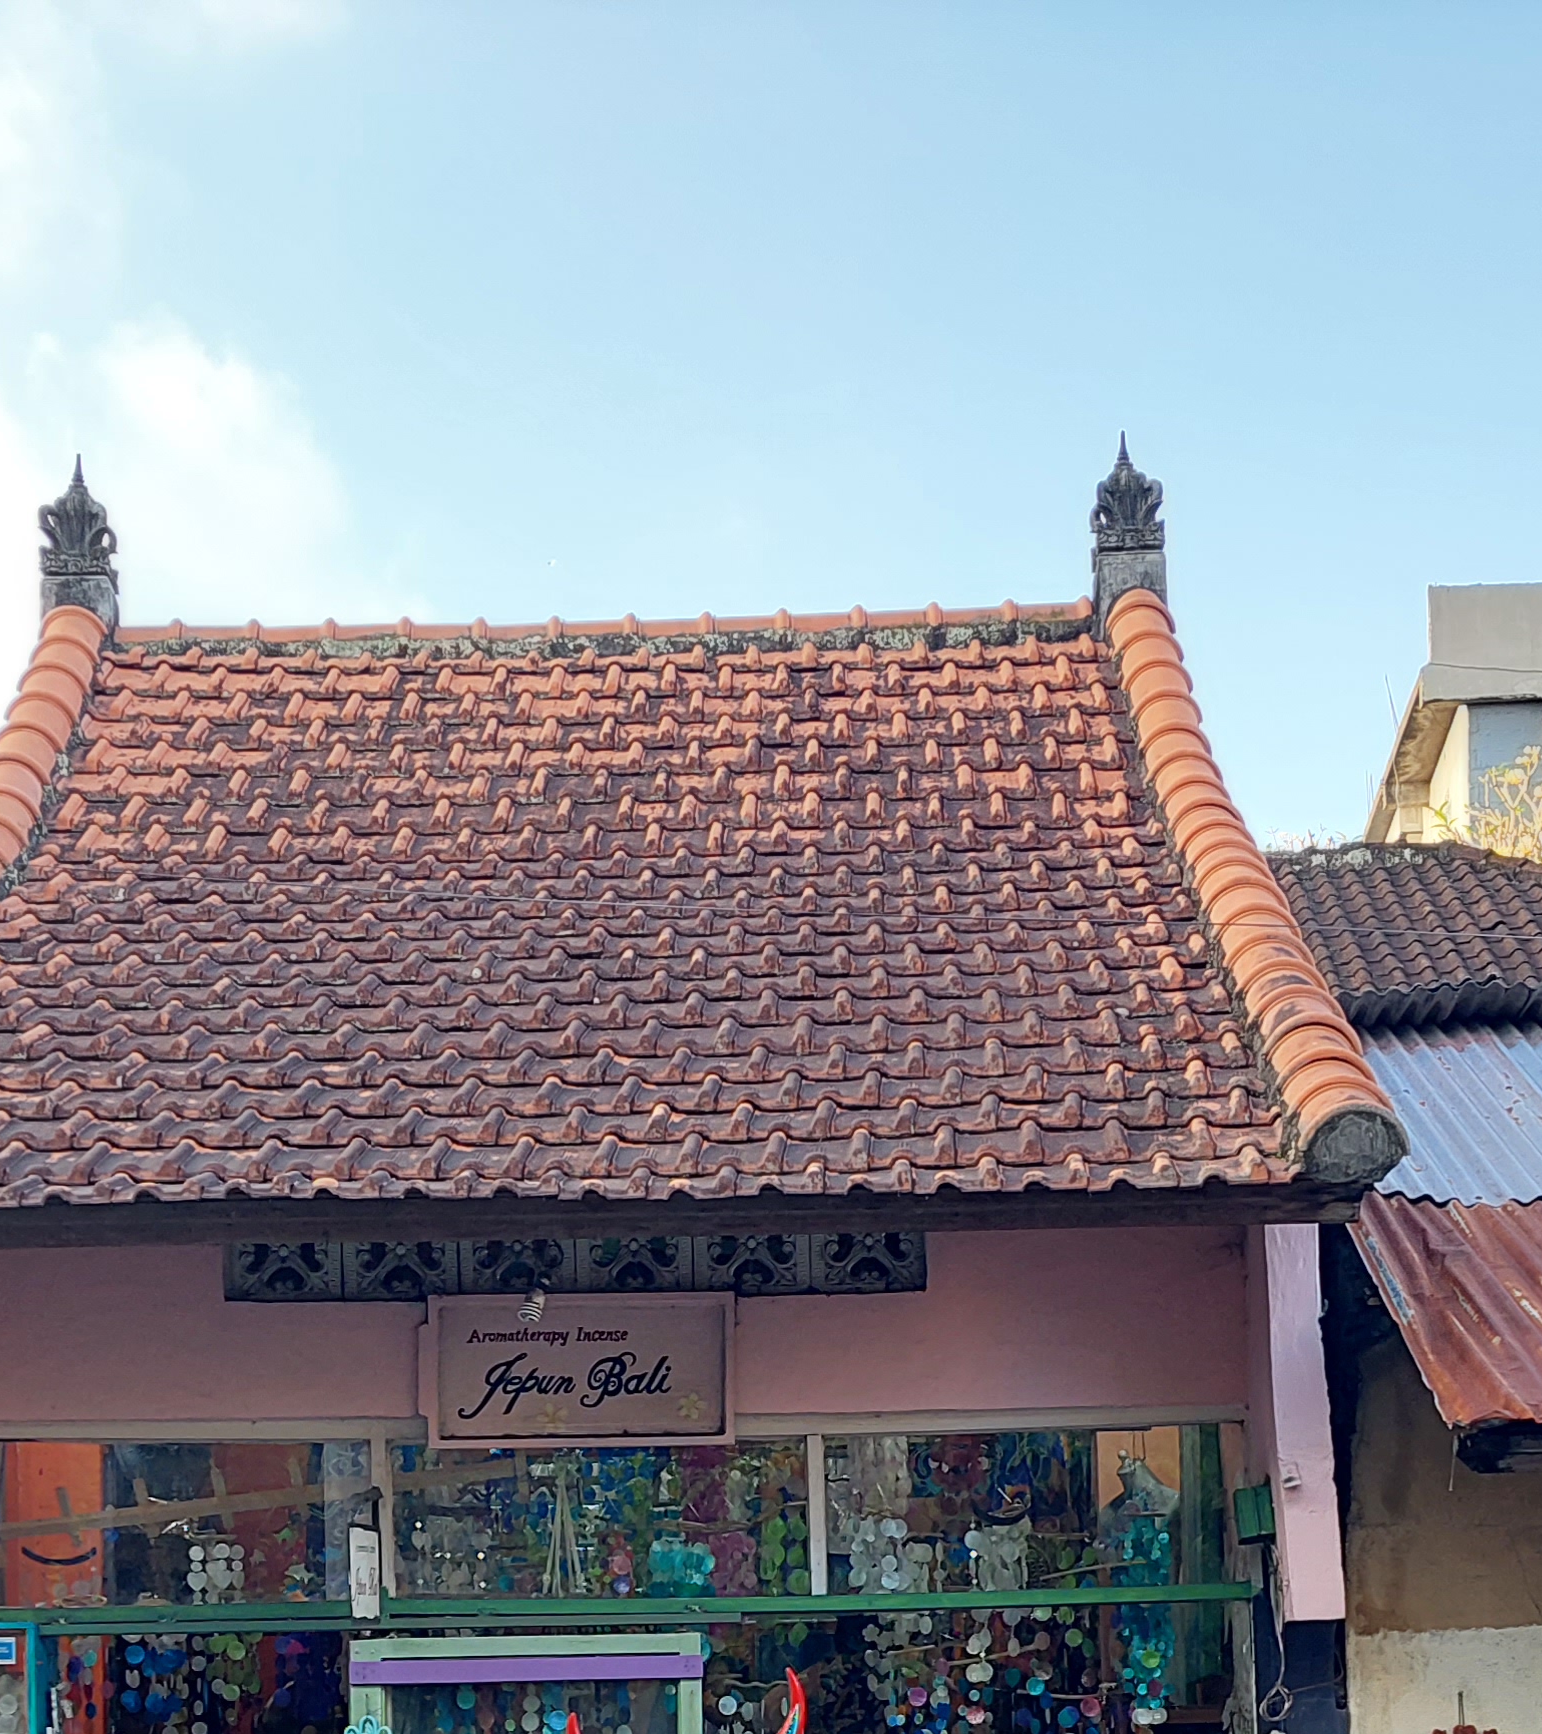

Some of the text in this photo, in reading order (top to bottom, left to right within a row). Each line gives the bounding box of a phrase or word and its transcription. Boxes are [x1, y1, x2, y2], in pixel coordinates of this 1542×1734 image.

[466, 1327, 629, 1347] Aromatherapy Incense
[457, 1351, 672, 1419] Jepun Bali
